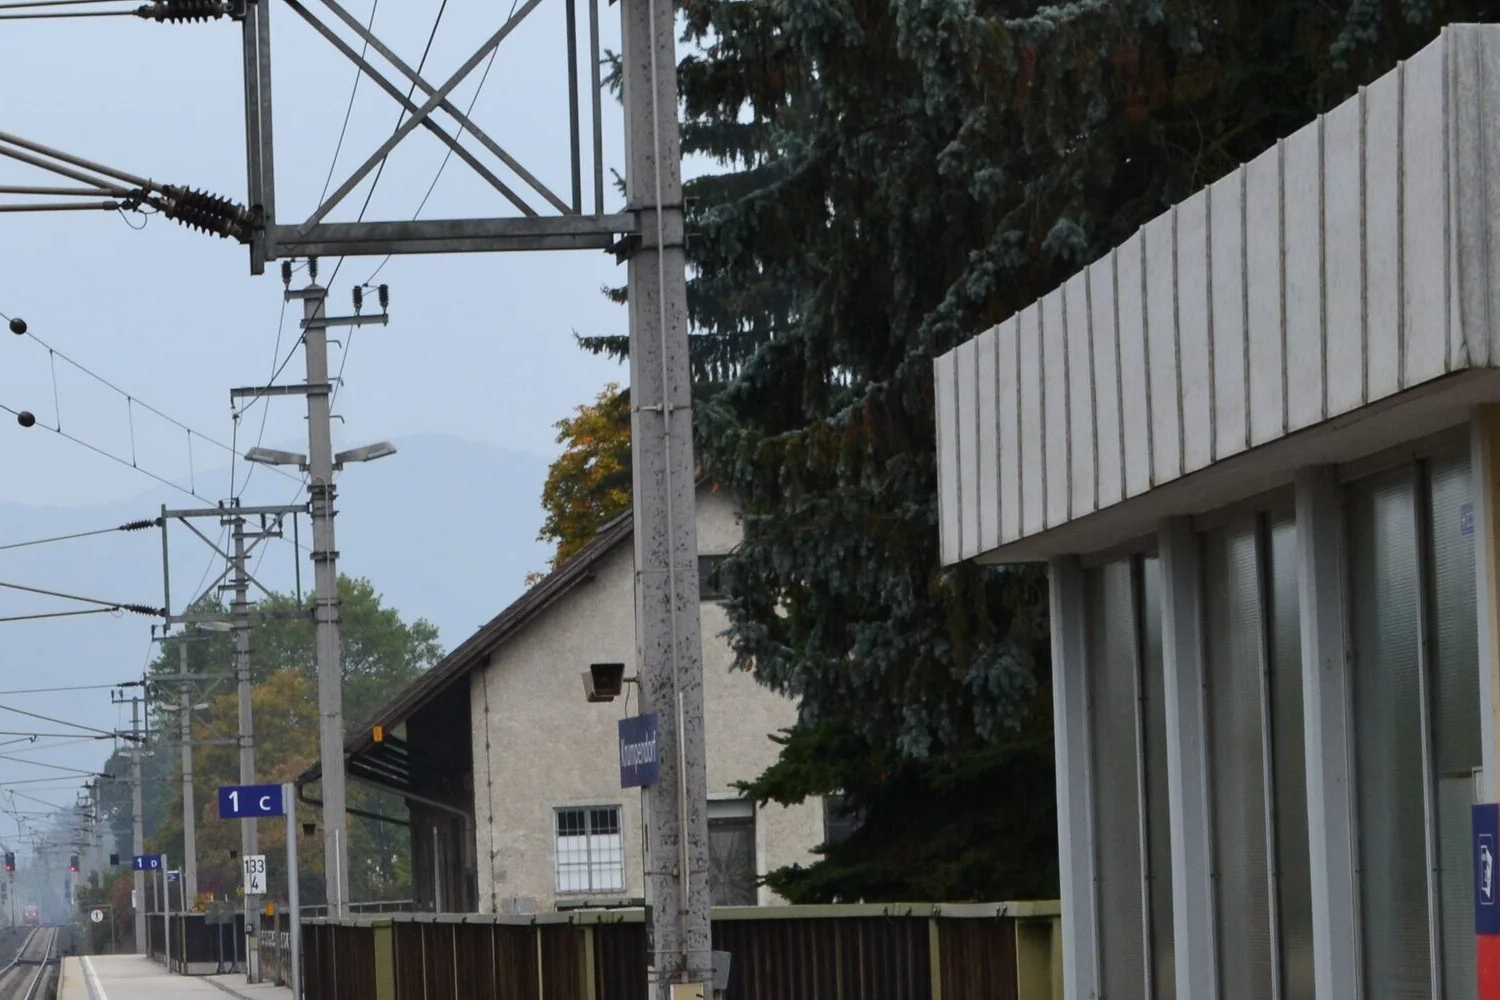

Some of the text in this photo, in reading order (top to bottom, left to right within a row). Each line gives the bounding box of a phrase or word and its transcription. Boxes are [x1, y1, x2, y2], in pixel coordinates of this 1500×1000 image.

[621, 730, 657, 774] Krumpendorf
[228, 790, 239, 813] 1
[136, 857, 158, 869] 1 D
[245, 859, 265, 875] 133
[251, 875, 259, 890] 4
